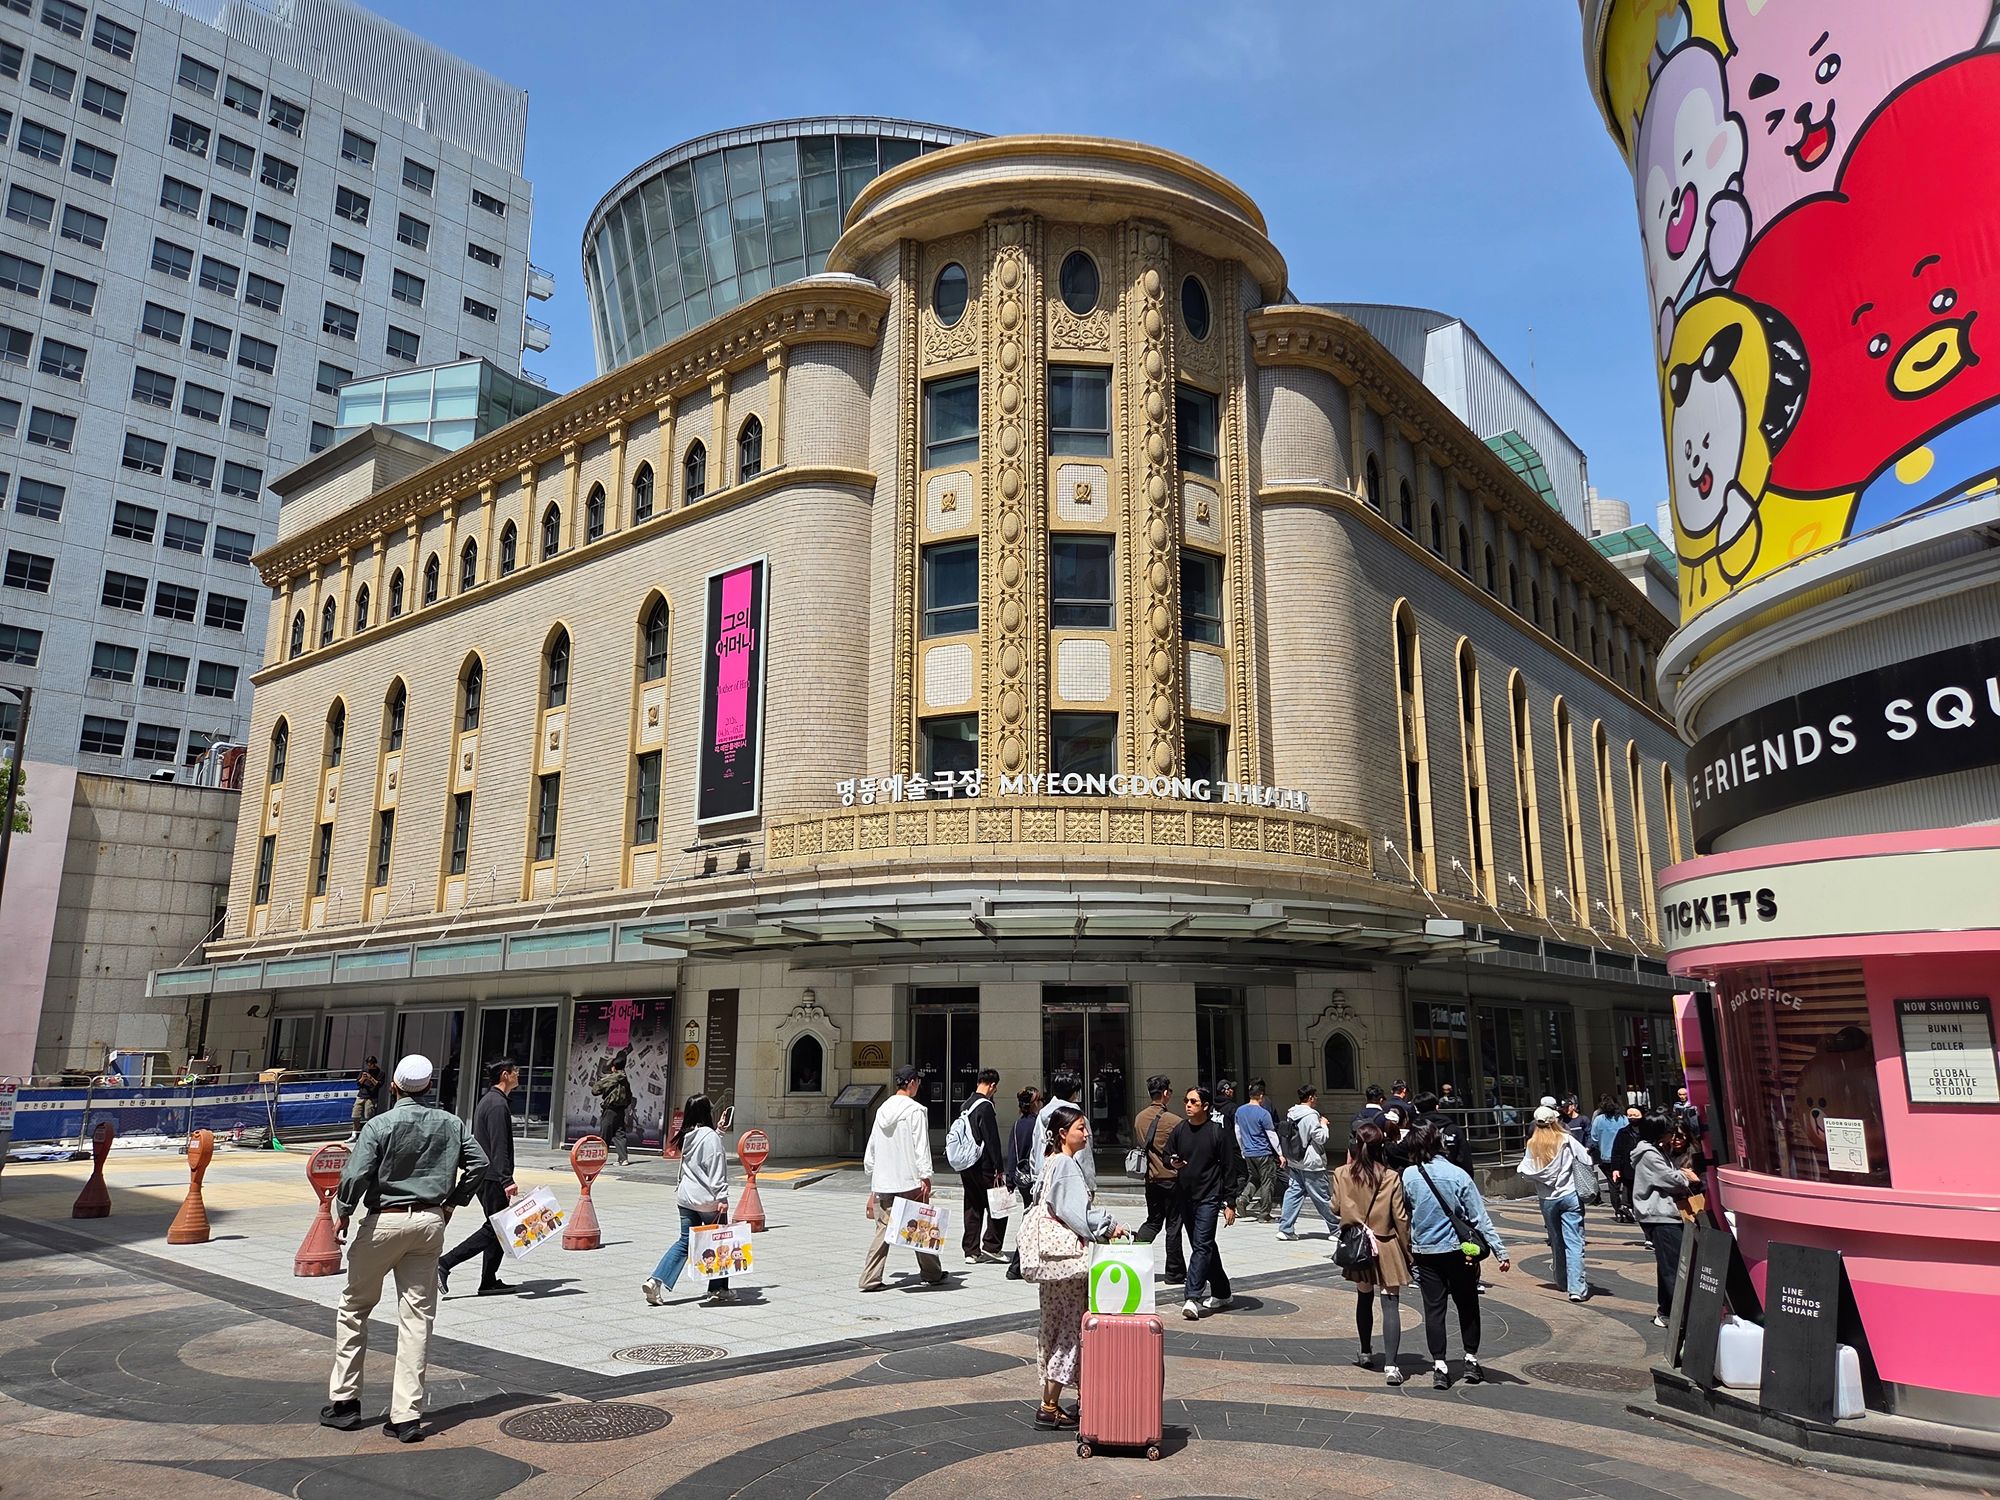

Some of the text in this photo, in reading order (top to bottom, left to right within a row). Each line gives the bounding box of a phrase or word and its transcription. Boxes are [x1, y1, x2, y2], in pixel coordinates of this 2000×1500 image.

[722, 608, 748, 632] 그의
[715, 628, 754, 657] 어머니
[1704, 714, 1857, 800] FRIENDS
[836, 768, 1311, 812] 명동예술극장 MYEONGDONG THEATER
[1664, 888, 1778, 932] TICKETS
[1730, 988, 1802, 1012] BOX OFFICE
[1904, 1001, 1980, 1012] NOW SHOWING
[1928, 1024, 1962, 1033] BUNINI
[1930, 1042, 1964, 1050] COLLER
[1933, 1068, 1970, 1078] GLOBAL
[1929, 1078, 1977, 1086] CREATIVE
[1936, 1087, 1973, 1096] STUDIO
[1701, 1266, 1712, 1274] LINE
[1700, 1274, 1718, 1286] FRIENDS
[1700, 1282, 1717, 1294] SQUARE
[1782, 1286, 1803, 1296] LINE
[1782, 1296, 1820, 1309] FRIENDS
[1781, 1304, 1819, 1318] SQUARE
